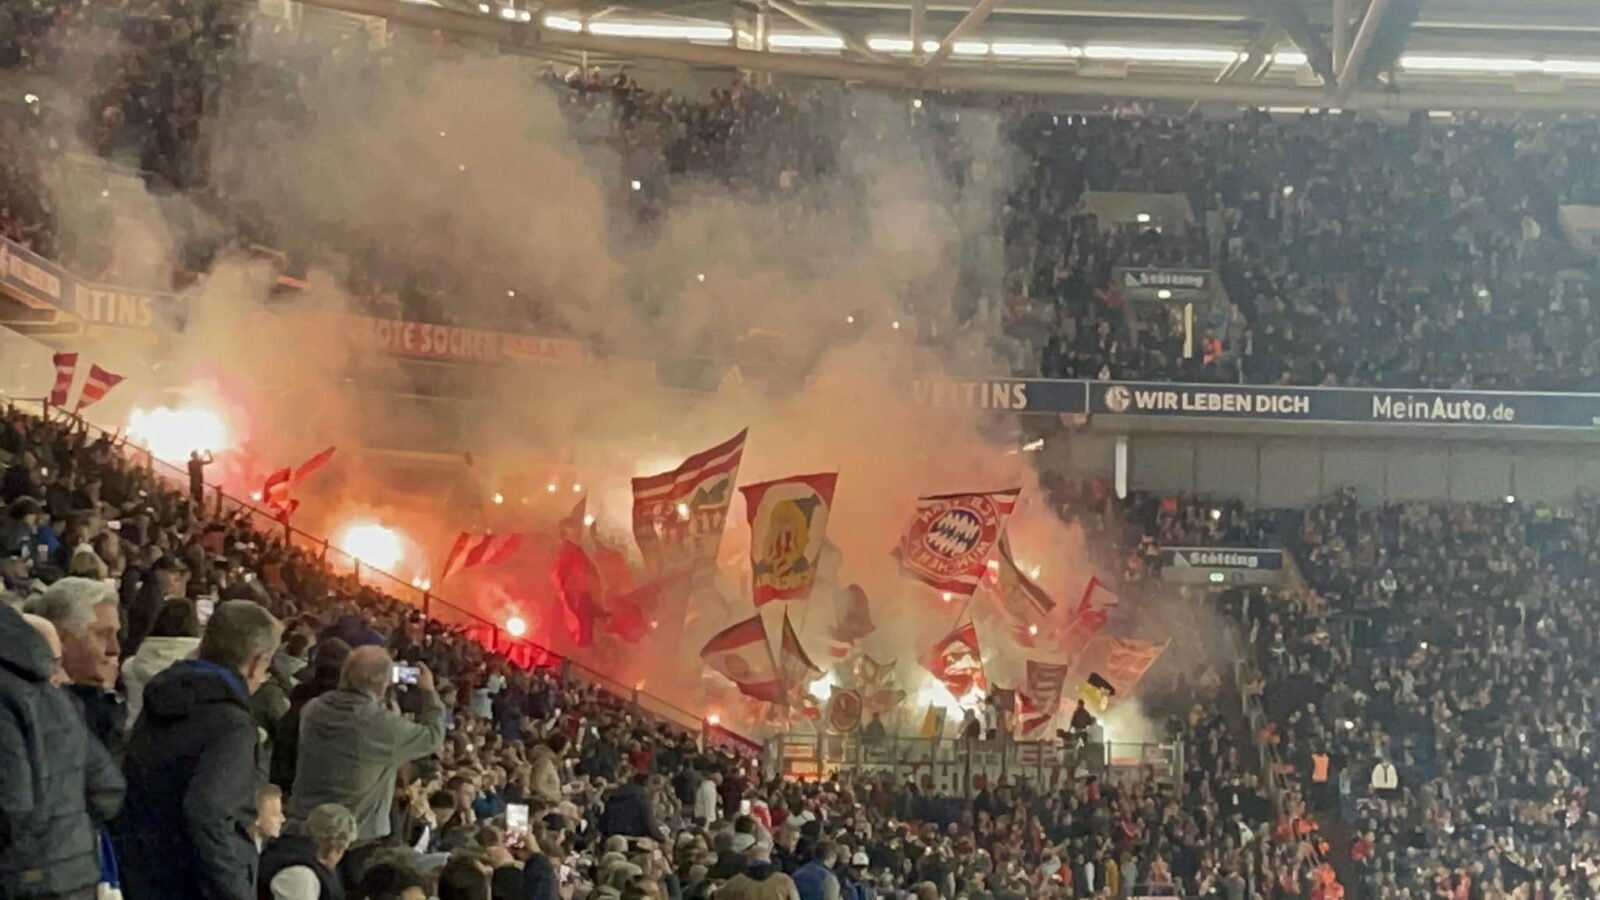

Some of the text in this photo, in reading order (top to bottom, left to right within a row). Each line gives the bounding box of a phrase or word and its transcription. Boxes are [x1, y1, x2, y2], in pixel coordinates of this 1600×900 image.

[1135, 390, 1178, 410] WIR
[1181, 391, 1252, 412] LEBEN
[1255, 394, 1310, 413] DICH
[1372, 395, 1514, 421] MeinAuto.de
